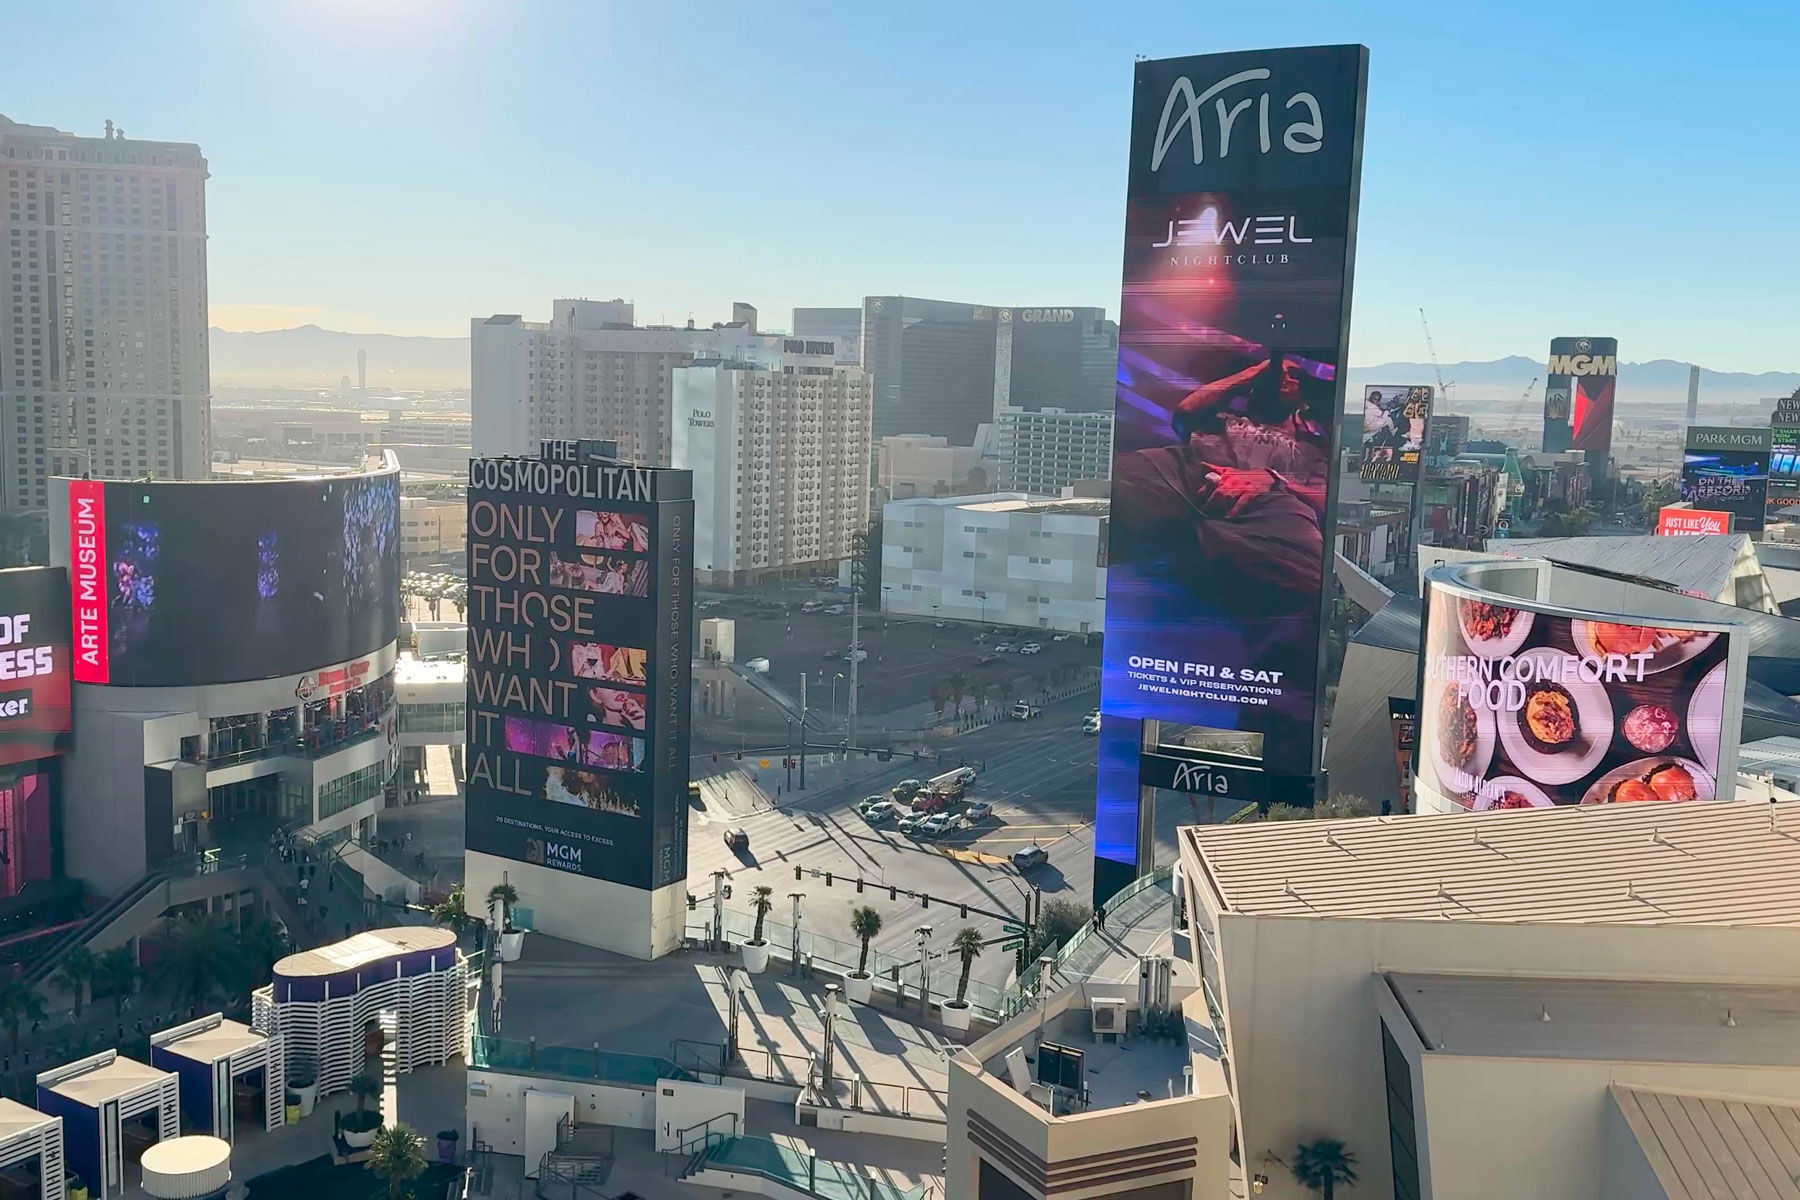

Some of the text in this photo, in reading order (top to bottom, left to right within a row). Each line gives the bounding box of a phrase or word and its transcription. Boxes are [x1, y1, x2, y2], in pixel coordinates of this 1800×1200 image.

[1150, 68, 1323, 172] Aria
[1152, 215, 1313, 247] JEWEL
[1171, 254, 1289, 266] NIGHTCLUB
[1022, 309, 1075, 322] GRAND
[1547, 354, 1615, 376] MGM
[1779, 412, 1800, 422] NEW
[1780, 400, 1800, 411] NEW
[541, 440, 577, 461] THE
[1696, 434, 1762, 445] PARK MGM
[470, 458, 651, 502] COSMOPOLITAN
[471, 501, 564, 544] ONLY
[672, 515, 681, 553] ONLY
[1665, 517, 1682, 528] JUST
[1683, 519, 1699, 529] LIKE
[472, 543, 541, 585] FOR
[671, 558, 680, 587] FOR
[78, 498, 99, 666] ARTE MUSEUM
[472, 585, 595, 635] THOSE
[670, 592, 680, 640] THOSE
[670, 643, 679, 680] WHO
[1128, 656, 1283, 684] OPEN FRI & SAT
[1500, 653, 1654, 683] COMFORT
[471, 668, 578, 718] WANT
[1127, 671, 1168, 682] TICKETS
[1180, 678, 1197, 686] VIP
[1199, 680, 1282, 695] RESERVATIONS
[1138, 683, 1268, 706] JEWELNIGHTCLUB.COM
[1457, 679, 1527, 712] FOOD
[471, 709, 499, 746] IT
[470, 752, 532, 796] ALL
[1172, 762, 1229, 794] Aria
[545, 826, 560, 834] YOUR
[560, 829, 582, 839] ACCESS
[547, 841, 582, 862] MGM
[547, 857, 582, 872] REWARDS
